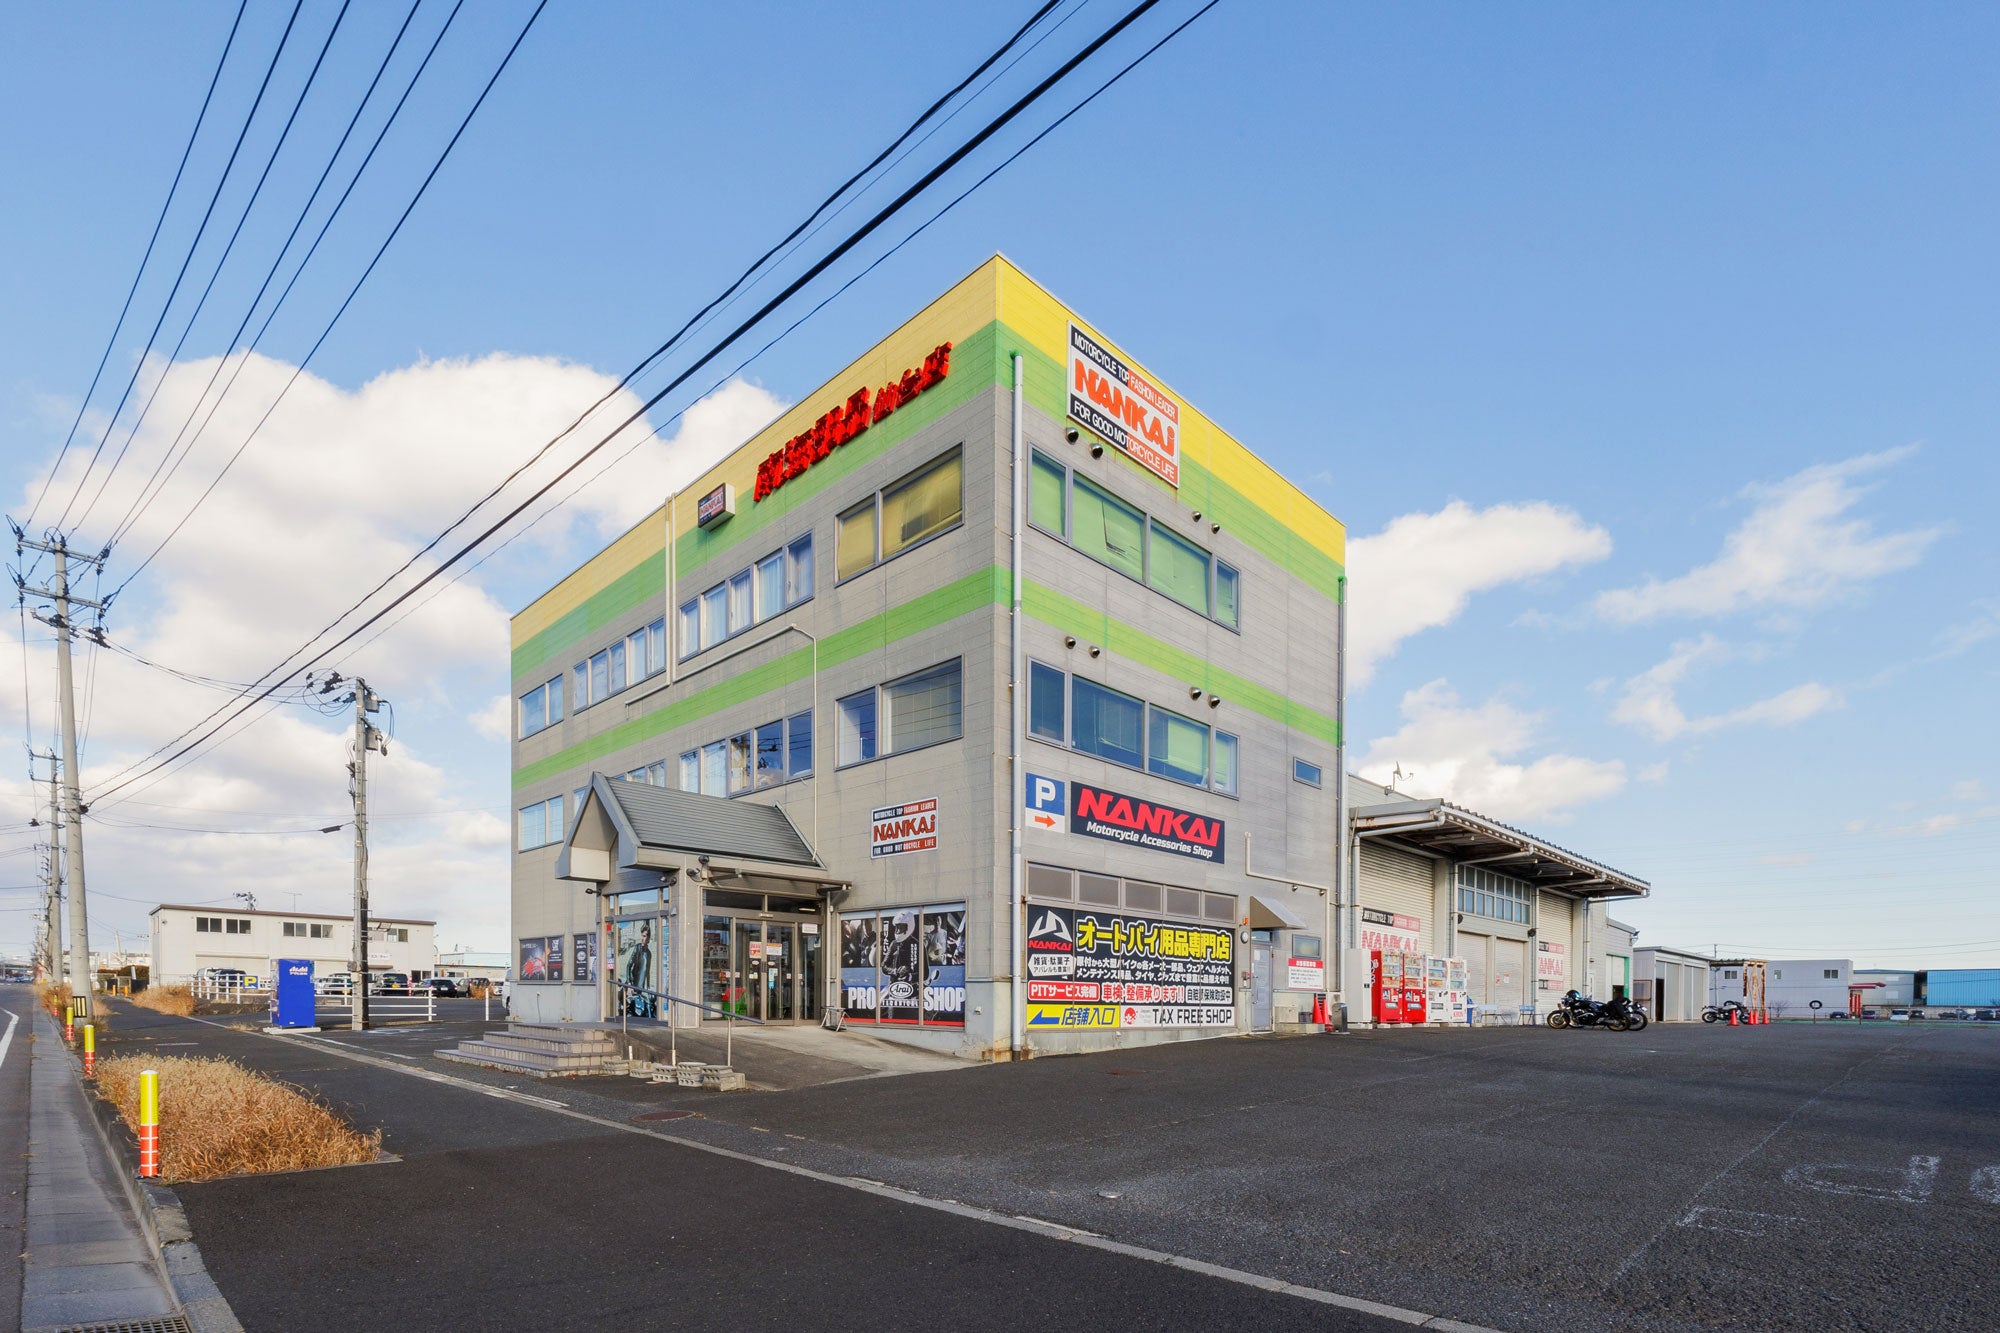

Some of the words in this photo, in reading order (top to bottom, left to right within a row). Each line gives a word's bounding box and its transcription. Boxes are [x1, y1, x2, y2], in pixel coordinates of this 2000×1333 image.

[1074, 332, 1117, 375] MOTORCYCLE
[1118, 366, 1130, 382] TOP
[1130, 375, 1155, 402] FASHION
[1154, 393, 1176, 417] LEADER
[1074, 401, 1091, 421] FOR
[1092, 413, 1114, 434] GOOD
[1114, 427, 1161, 468] MOTORCYCLE
[1161, 461, 1175, 479] LIFE
[1036, 778, 1056, 808] P
[1077, 788, 1221, 847] NANKAI
[1086, 821, 1139, 842] Motorcycle
[1140, 834, 1192, 854] Accessories
[1192, 845, 1213, 859] Shop
[1028, 940, 1072, 951] NANKAI
[1078, 919, 1230, 960] オートバイ用品専門店
[244, 976, 257, 987] P
[847, 987, 877, 1009] PRO
[923, 986, 966, 1012] SHOP
[1061, 1007, 1116, 1026] 店舗入口
[1153, 1008, 1174, 1024] TAX
[1177, 1009, 1204, 1024] FREE
[1205, 1009, 1232, 1024] SHOP
